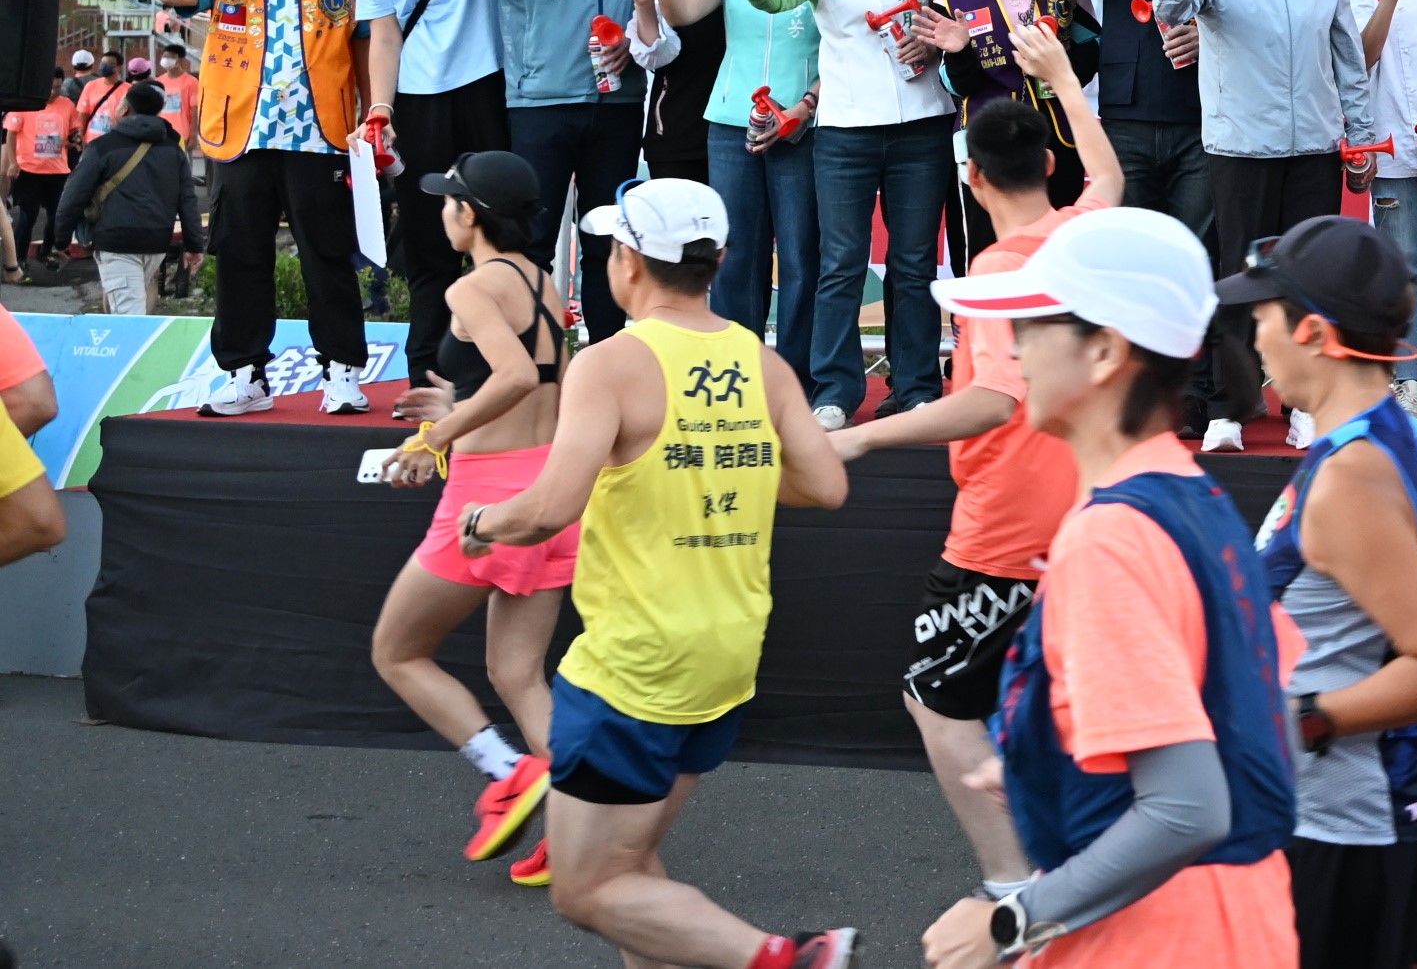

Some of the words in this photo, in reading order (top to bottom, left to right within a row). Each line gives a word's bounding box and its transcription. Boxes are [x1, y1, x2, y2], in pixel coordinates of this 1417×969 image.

[73, 346, 118, 357] VITALON
[677, 418, 712, 432] Guide
[716, 419, 762, 431] Runner
[714, 442, 774, 469] 陪跑員
